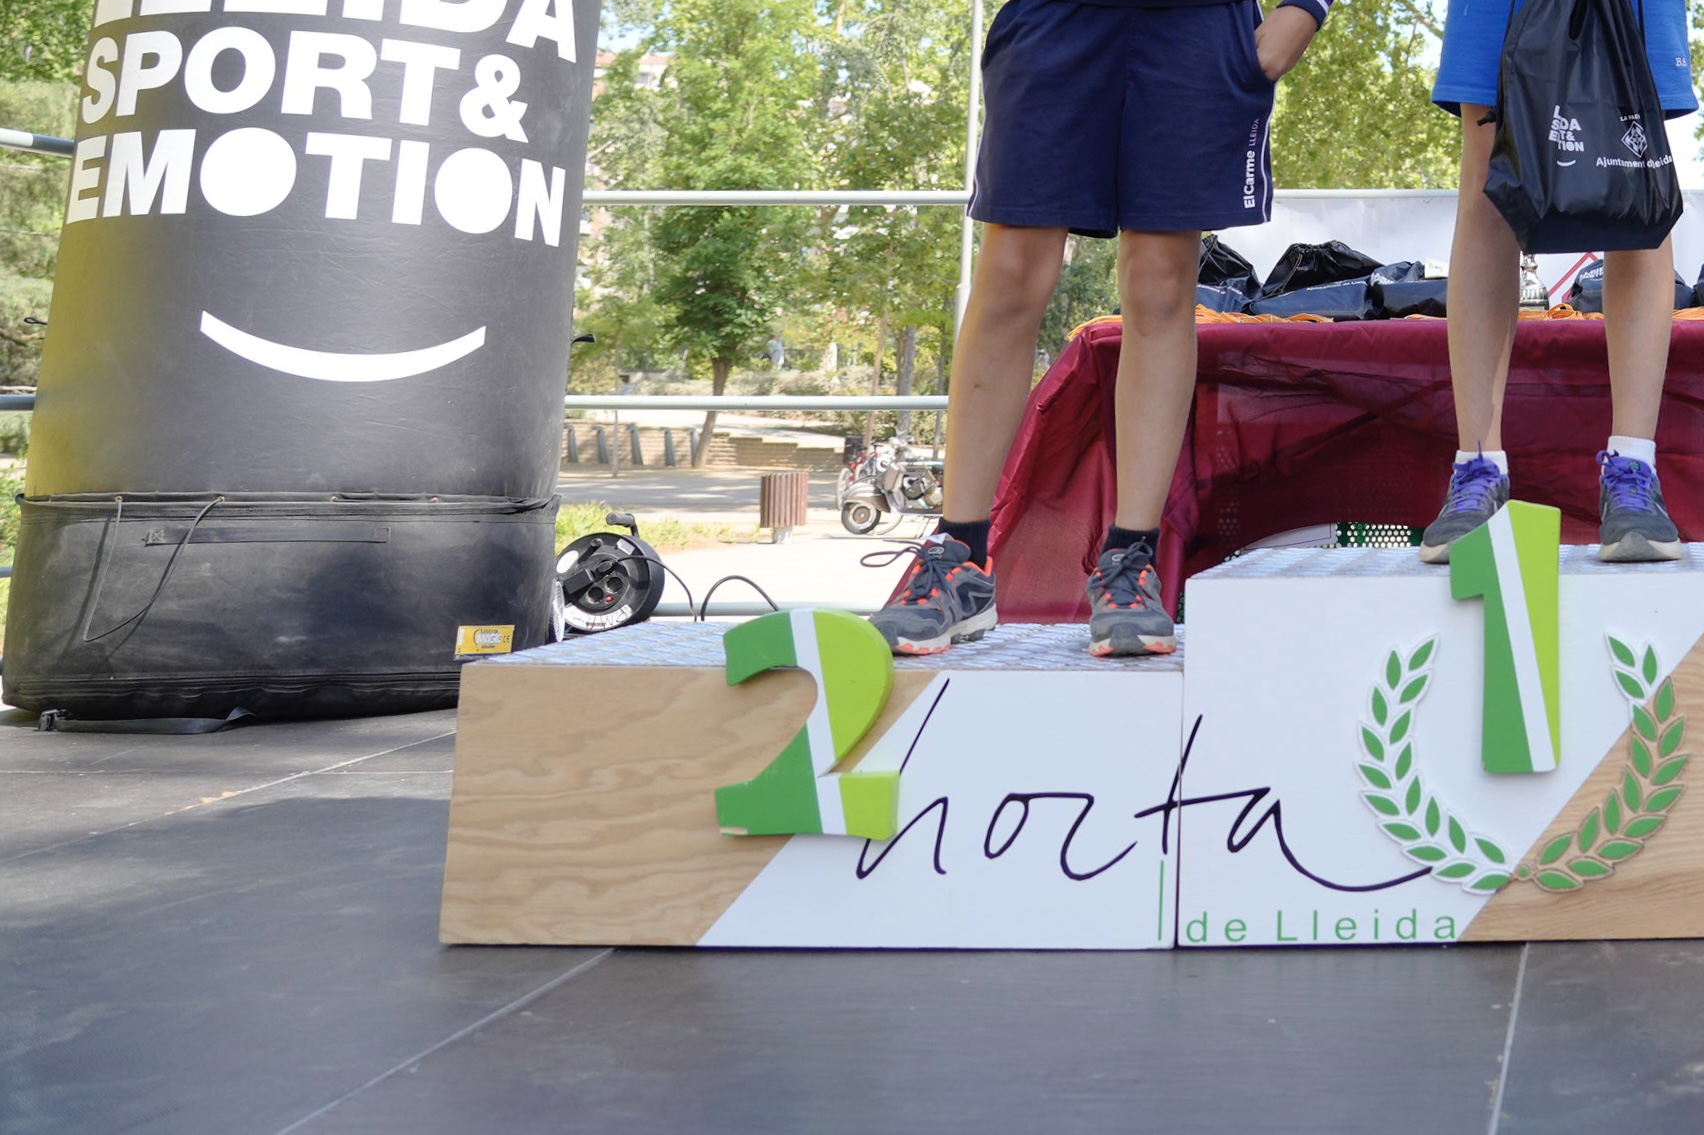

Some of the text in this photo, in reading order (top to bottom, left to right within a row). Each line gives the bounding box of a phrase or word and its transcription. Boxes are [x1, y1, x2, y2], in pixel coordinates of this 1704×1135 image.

[65, 126, 567, 249] EMOTION
[1248, 118, 1260, 147] LLEIDA
[1450, 500, 1561, 773] 1
[715, 607, 899, 841] 2
[1186, 908, 1457, 943] de Lleida
